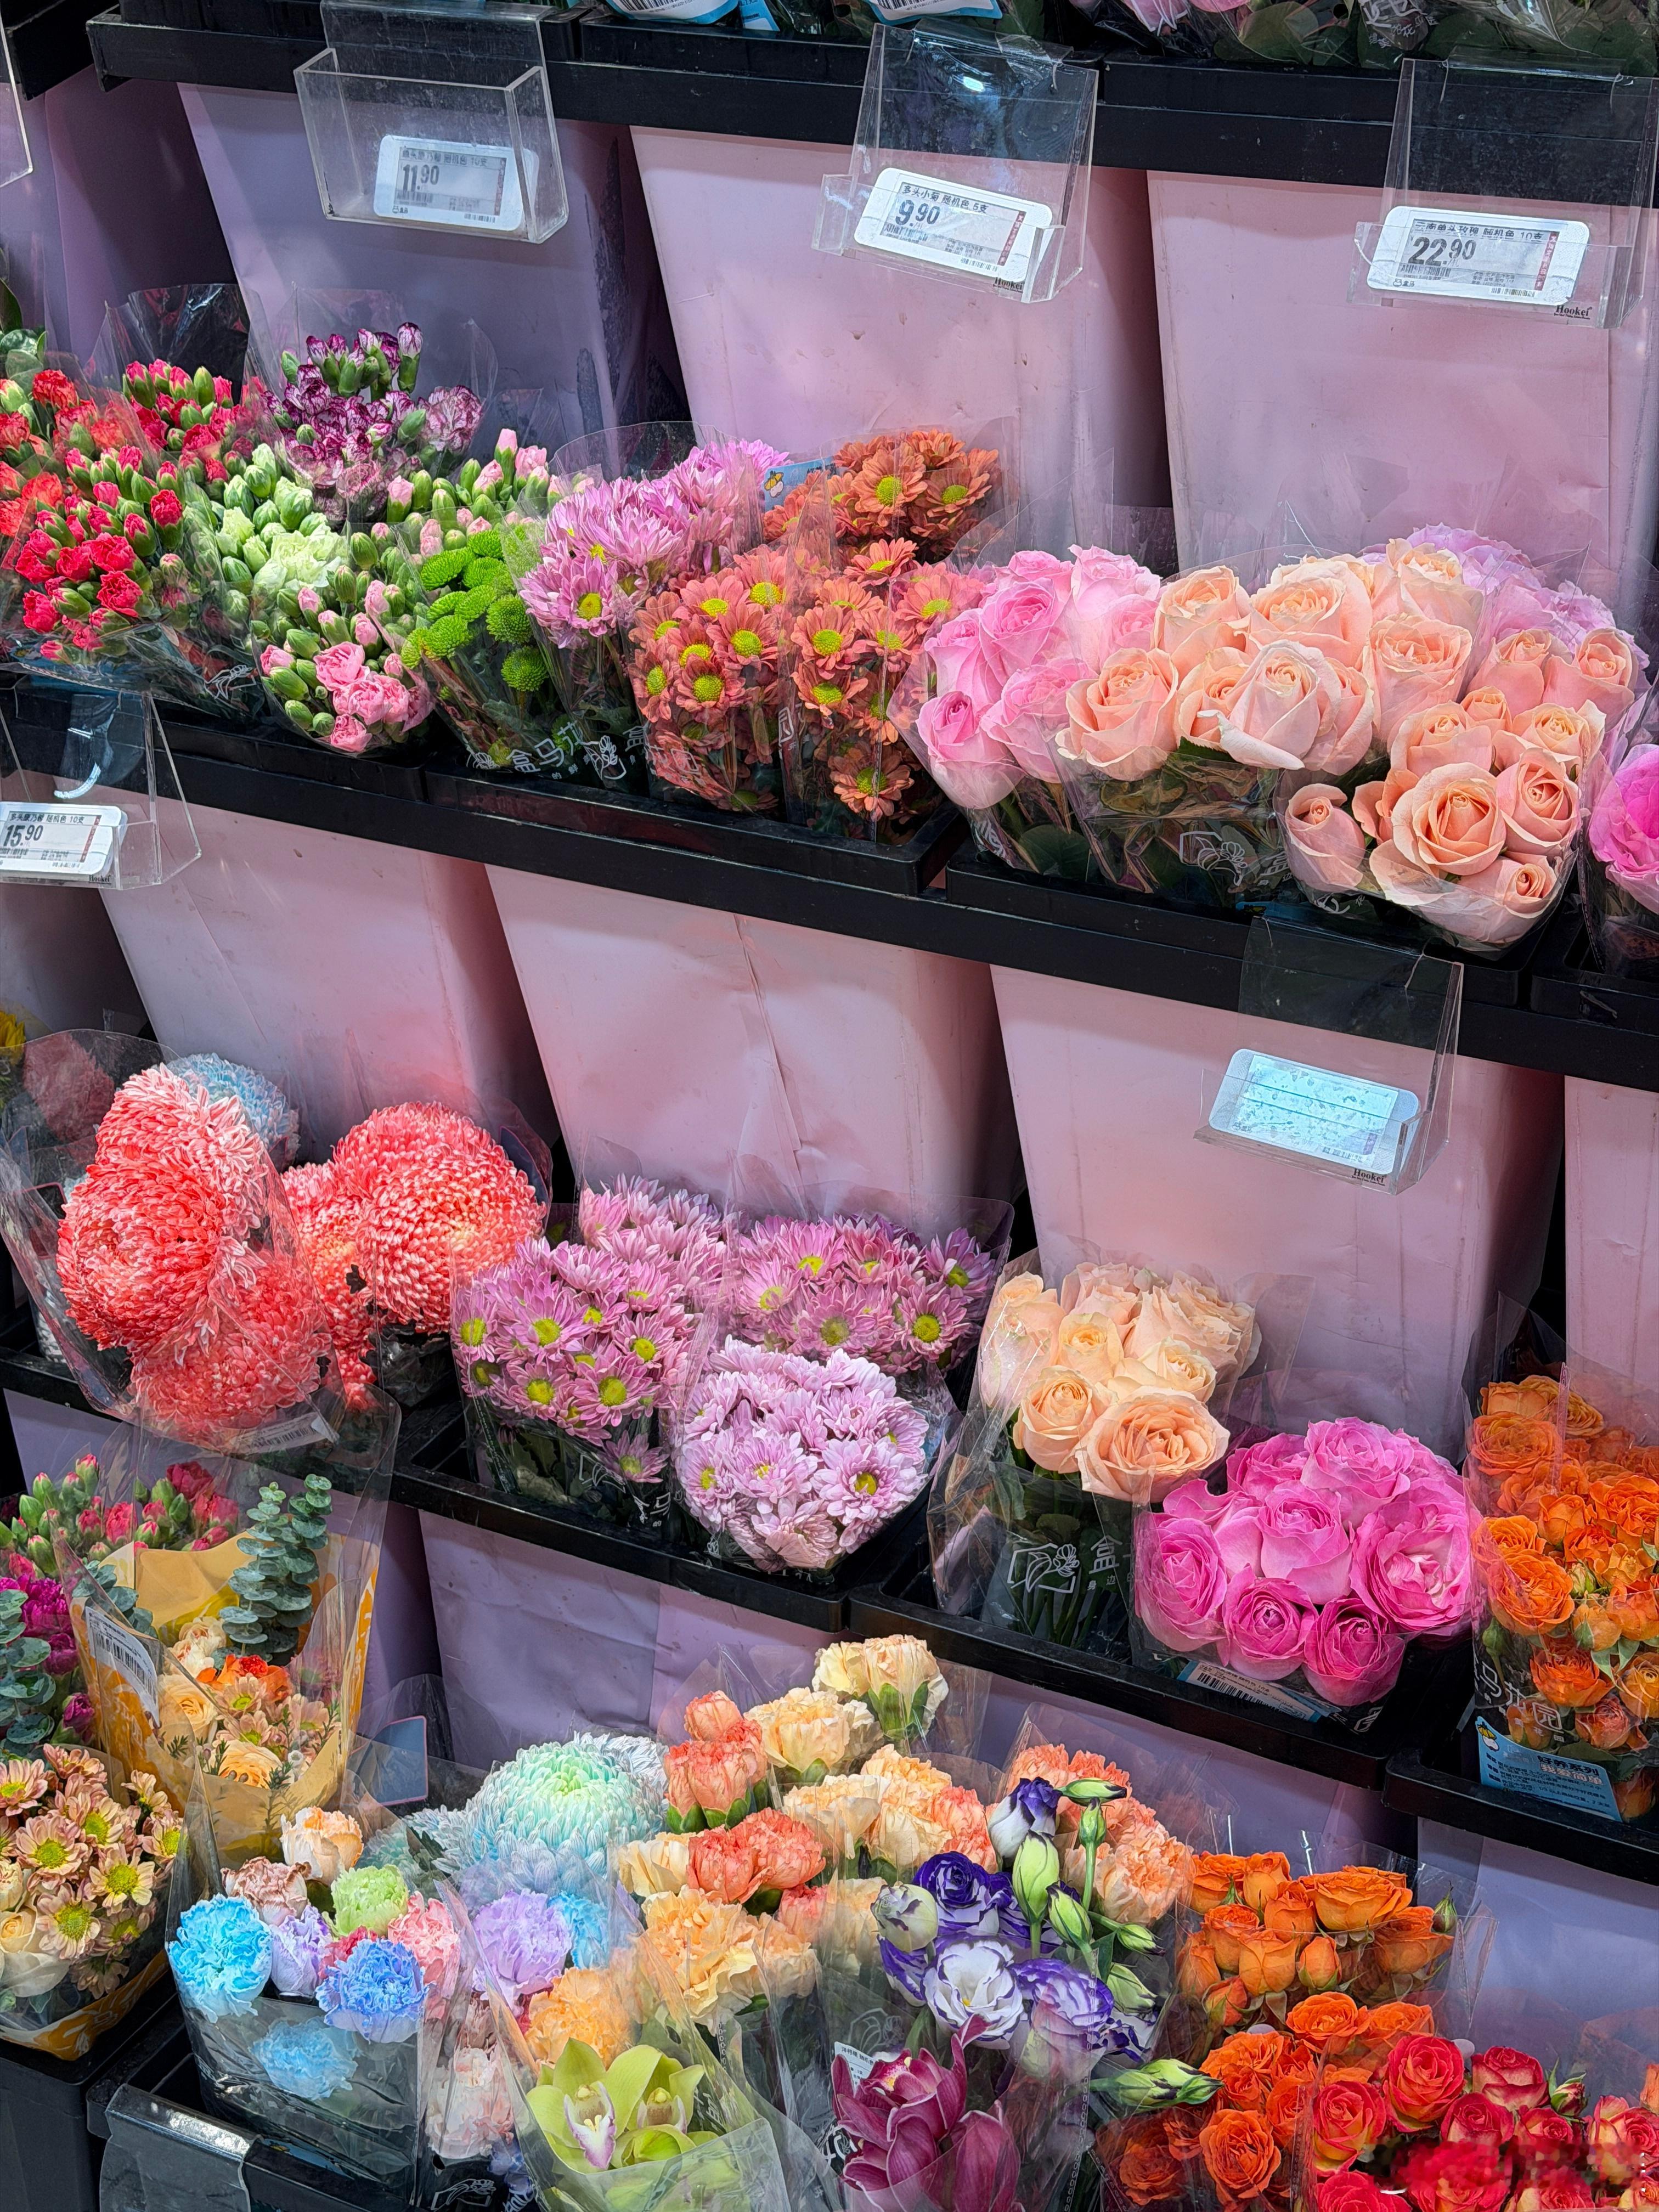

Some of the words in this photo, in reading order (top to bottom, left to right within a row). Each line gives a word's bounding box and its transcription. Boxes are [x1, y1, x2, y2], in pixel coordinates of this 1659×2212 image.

[402, 164, 440, 191] 11.90
[903, 185, 939, 203] 多头小菊
[941, 194, 970, 210] 随机色
[973, 202, 990, 214] 5支
[895, 199, 940, 227] 9.90
[1407, 236, 1477, 267] 22.90
[1555, 304, 1590, 318] Hookei
[70, 816, 85, 824] 10支
[3, 825, 44, 847] 15.90
[1353, 1167, 1385, 1182] Hookei
